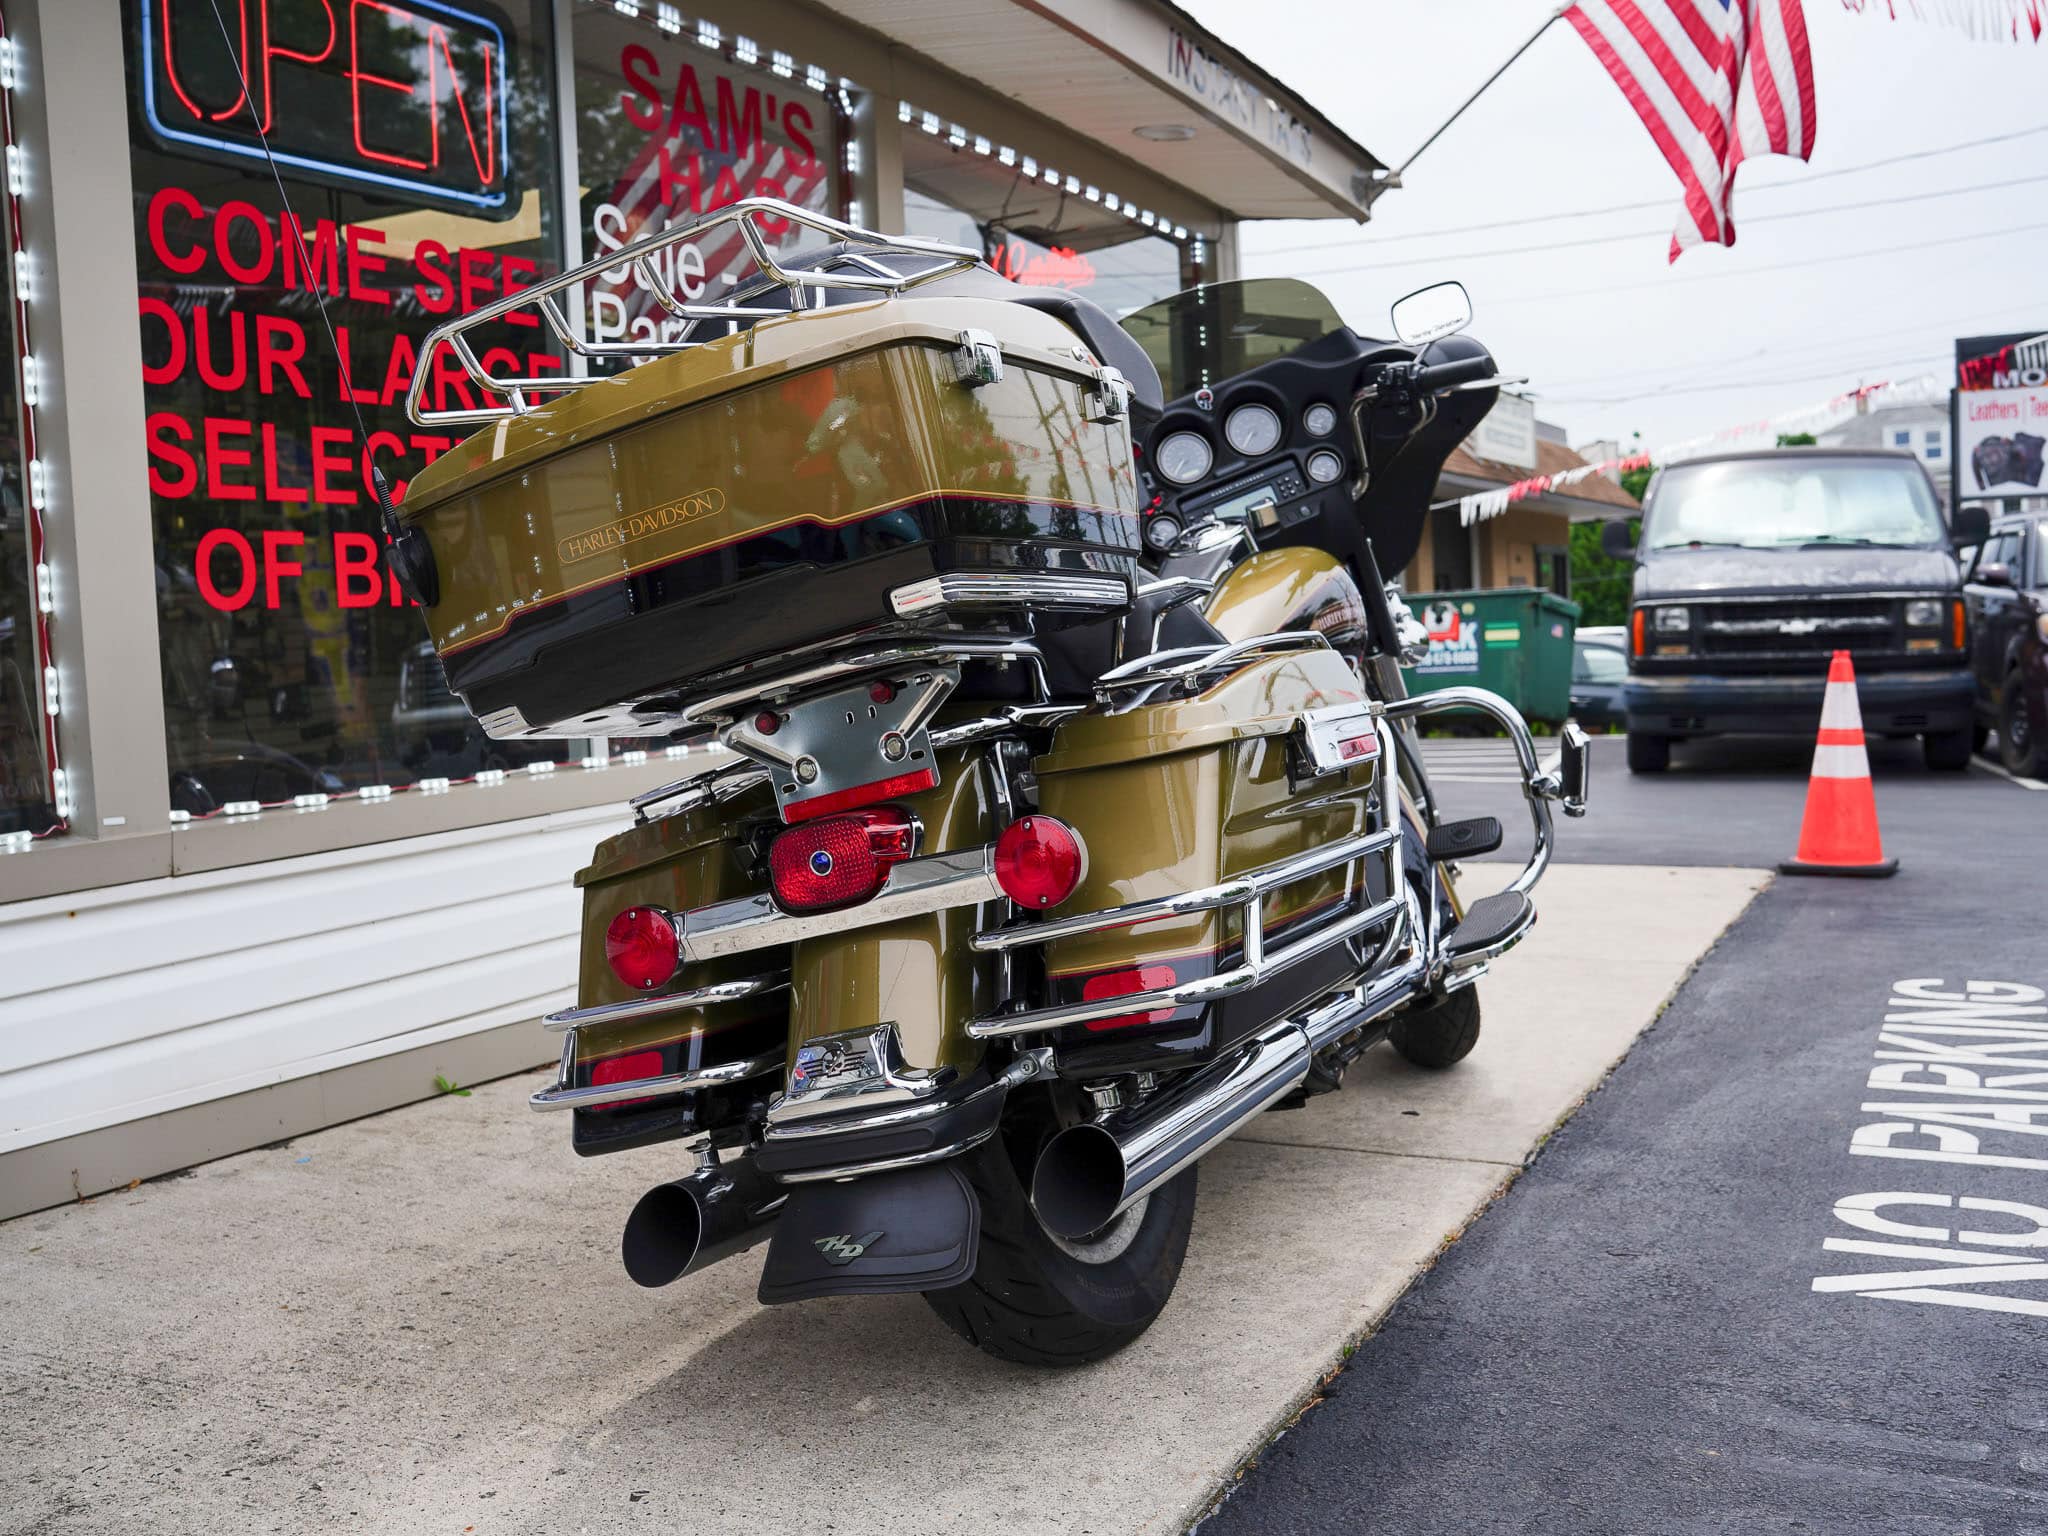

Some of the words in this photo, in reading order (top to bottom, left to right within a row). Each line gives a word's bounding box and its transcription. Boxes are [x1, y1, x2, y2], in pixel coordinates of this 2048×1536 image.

[162, 0, 493, 185] OPEN
[621, 44, 816, 177] SAM'S
[659, 147, 790, 235] HAS
[148, 187, 391, 305] COME
[414, 239, 540, 327] SEE
[138, 296, 312, 399] OUR
[336, 326, 562, 408] LARGE
[146, 412, 465, 505] SELECT
[195, 527, 305, 612] OF
[568, 493, 713, 558] HARLEY-DAVIDSON
[1849, 978, 2048, 1171] PARKING
[1811, 1191, 2048, 1318] NO
